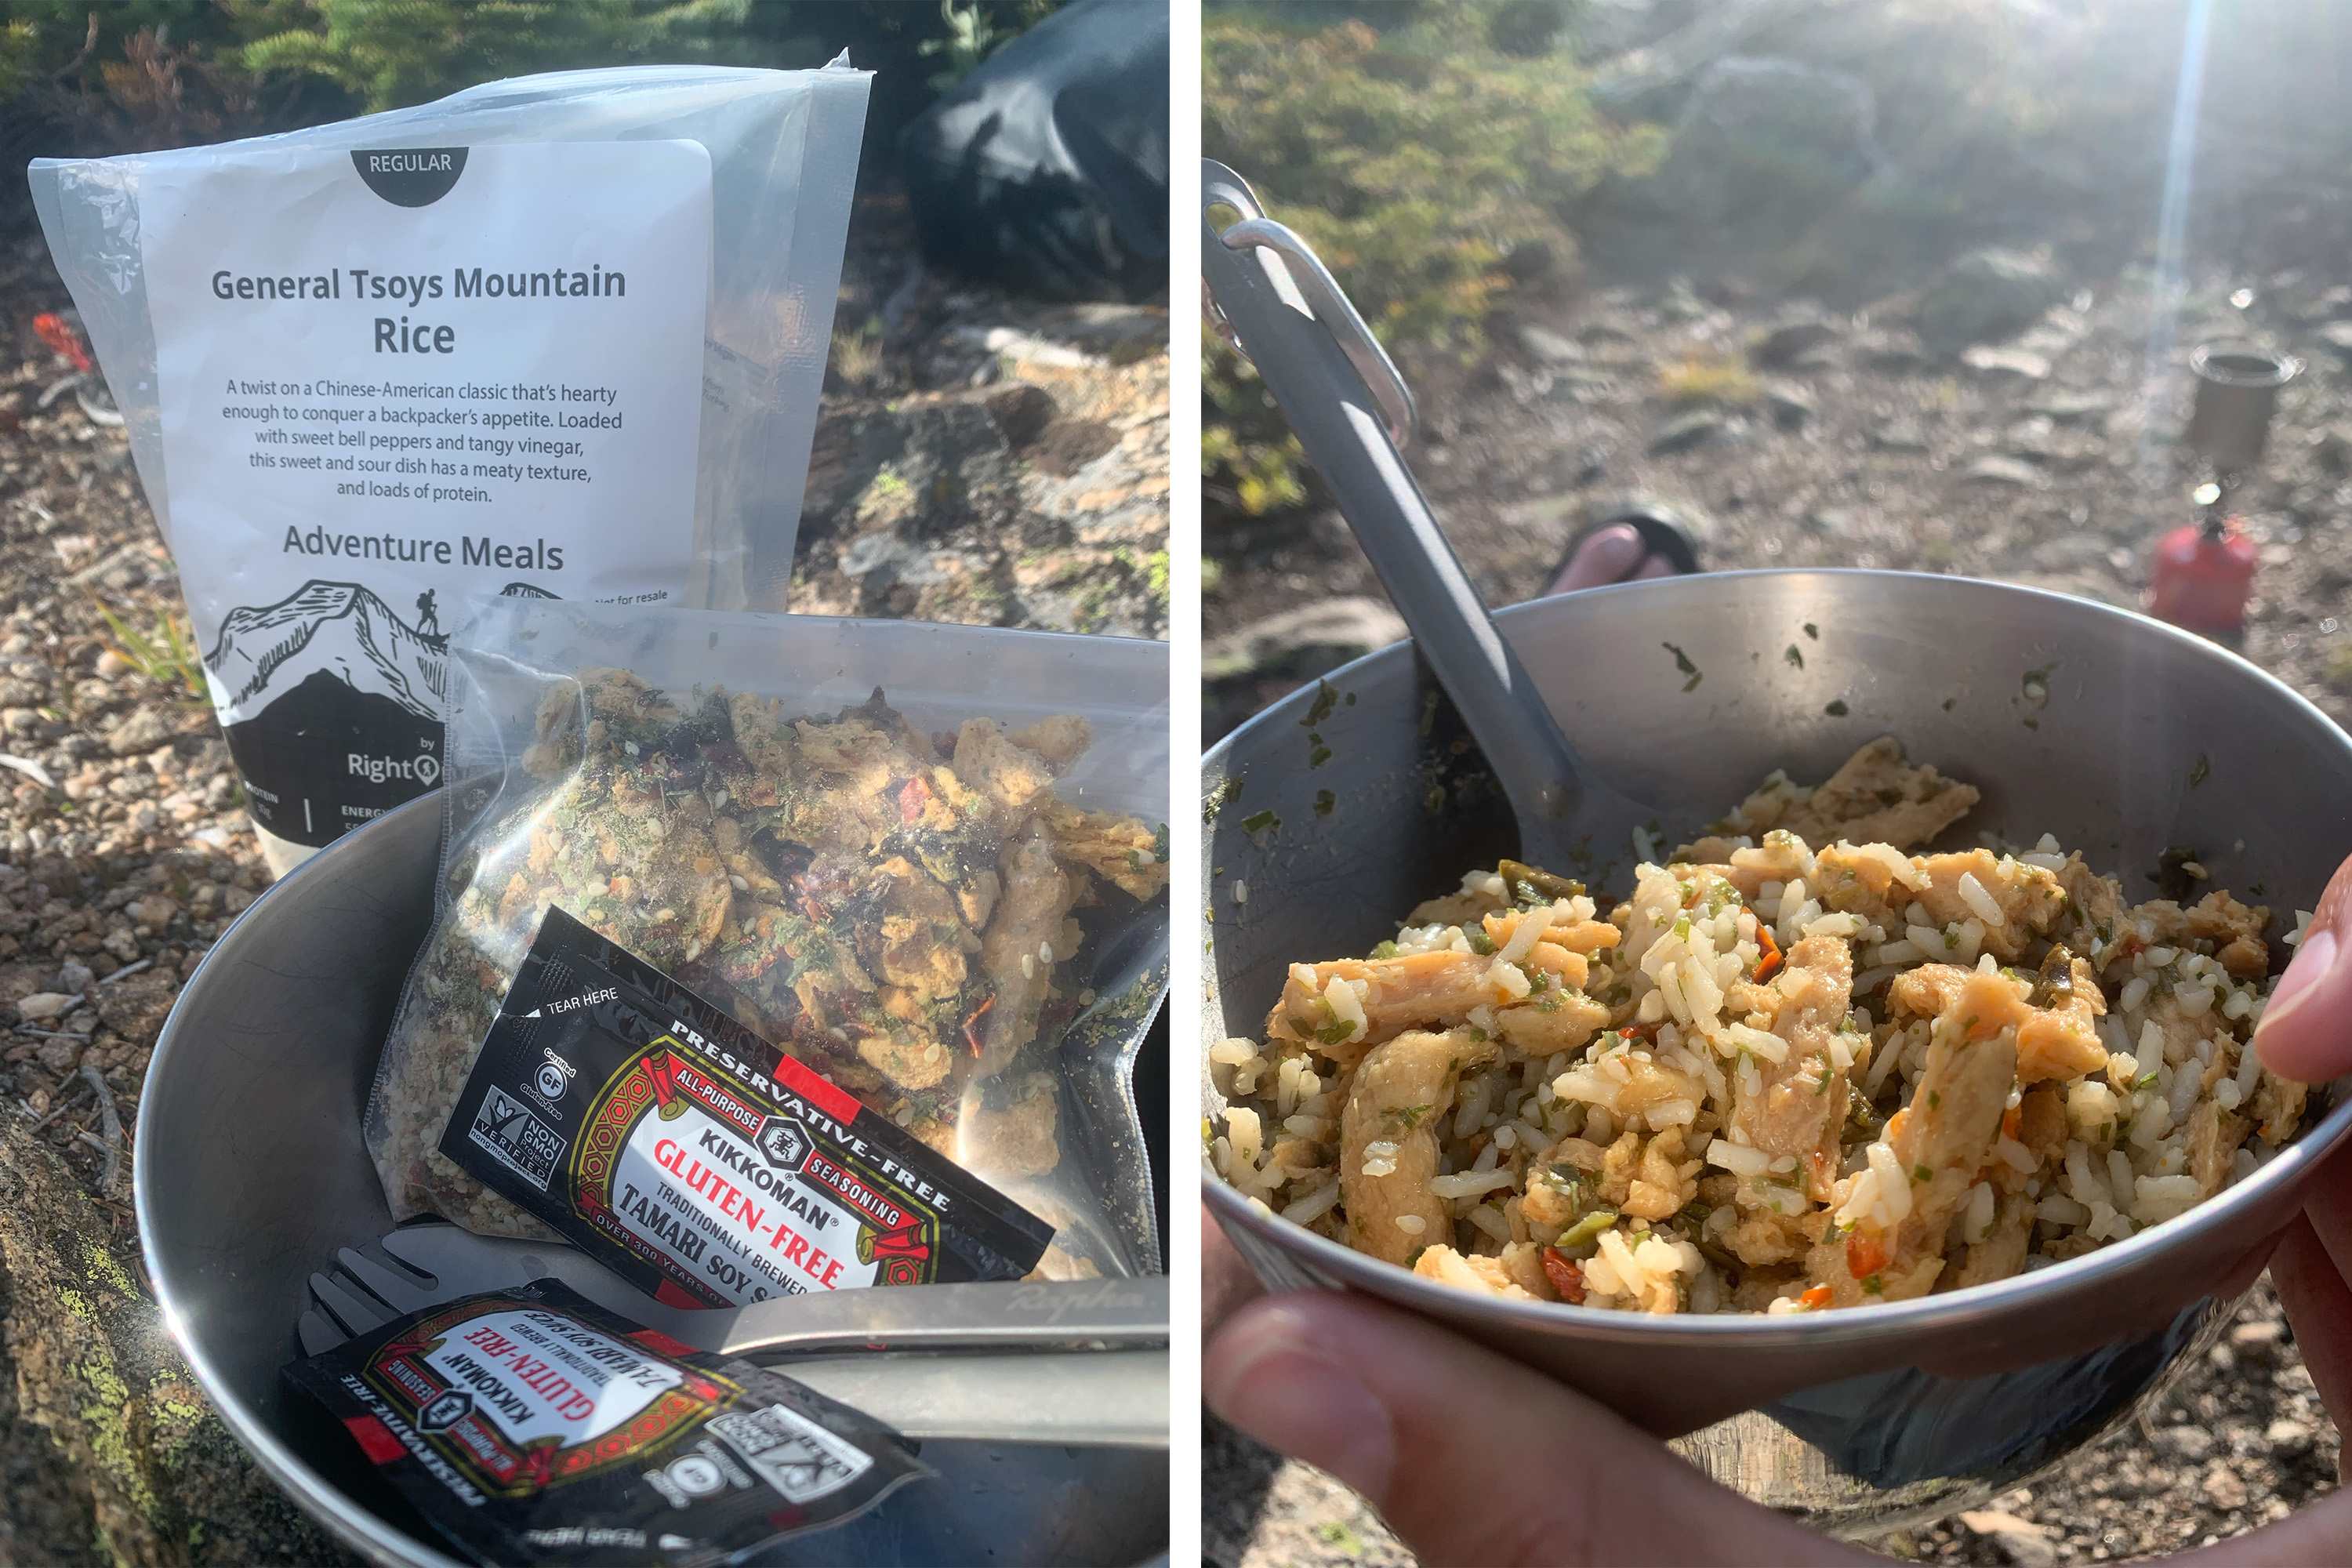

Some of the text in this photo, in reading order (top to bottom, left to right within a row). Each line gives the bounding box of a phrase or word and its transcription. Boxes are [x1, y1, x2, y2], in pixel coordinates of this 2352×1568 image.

[369, 154, 452, 172] REGULAR
[211, 264, 626, 307] General Tsoys Mountain
[373, 315, 456, 354] Rice
[226, 379, 237, 394] A
[241, 380, 276, 395] twist
[281, 383, 299, 395] on
[303, 383, 312, 396] a
[316, 380, 454, 398] Chinese-American
[459, 383, 508, 400] classic
[561, 384, 617, 406] hearty
[222, 404, 278, 423] enough
[283, 406, 298, 420] to
[303, 408, 364, 424] conquer
[368, 410, 376, 422] a
[482, 411, 554, 430] appetite.
[558, 412, 622, 429] Loaded
[255, 429, 584, 458] with sweet bell peppers and tangy vinegar,
[249, 452, 591, 483] this sweet and sour dish has a meaty texture,
[337, 481, 492, 503] and loads of protein.
[282, 525, 564, 571] Adventure Meals
[617, 596, 633, 605] for
[636, 590, 668, 603] resale
[420, 737, 435, 751] by
[547, 987, 619, 1015] TEAR HERE
[544, 1047, 575, 1077] Certified
[542, 1072, 561, 1091] GF
[520, 1083, 563, 1121] Gluten-Free
[676, 1069, 762, 1131] ALL-PURPOSE
[478, 1123, 546, 1178] VERIFIED
[524, 1131, 555, 1161] GMO
[528, 1120, 560, 1152] NON
[470, 1131, 547, 1190] nongmoproject.org
[520, 1139, 550, 1170] Project
[810, 1157, 901, 1227] SEASONING
[656, 1181, 753, 1260] TRADITIONALLY
[596, 1215, 630, 1243] OVER
[633, 1240, 658, 1261] 300
[663, 1258, 704, 1293] YEARS
[619, 1183, 753, 1294] TAMARI SOY
[510, 1323, 550, 1345] BREWED
[387, 1359, 437, 1403] SEASONING
[463, 1327, 595, 1421] GLUTEN-FREE
